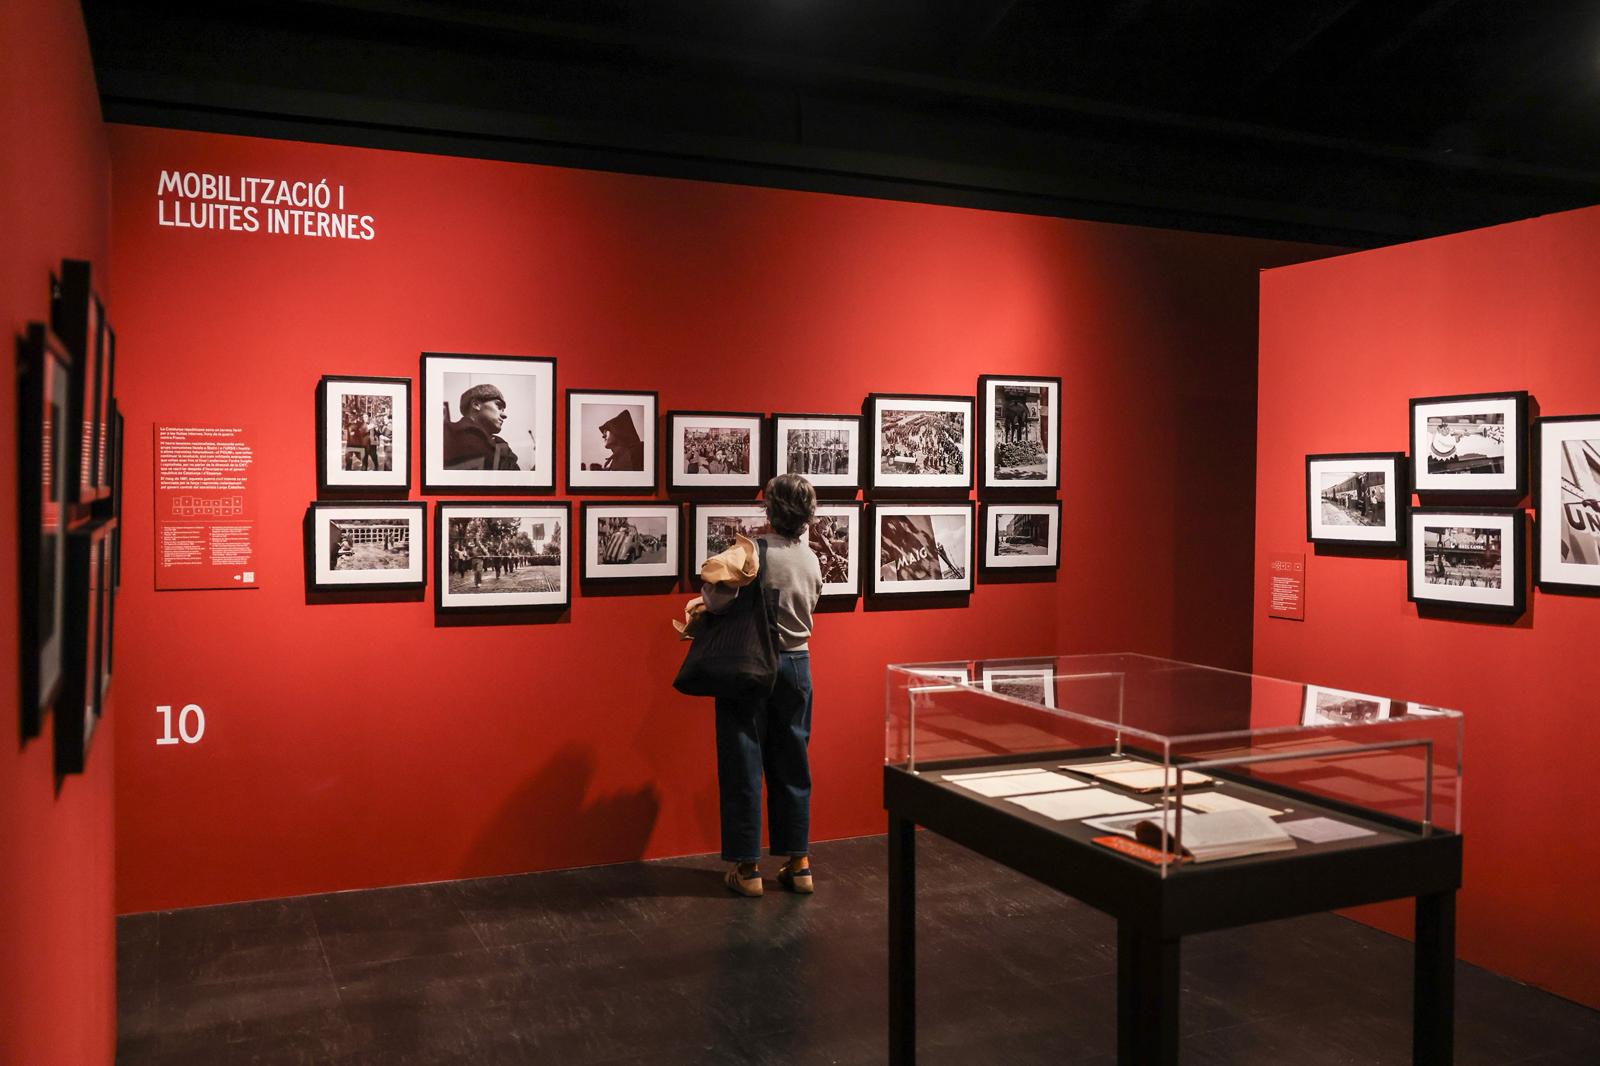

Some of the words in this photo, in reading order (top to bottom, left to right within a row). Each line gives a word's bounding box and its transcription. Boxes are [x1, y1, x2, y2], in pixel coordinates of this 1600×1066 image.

[157, 170, 331, 209] MOBILITZACIÓ
[338, 185, 344, 210] I
[158, 199, 260, 233] LLUITES
[267, 207, 376, 241] INTERNES
[897, 546, 928, 571] MAIG
[156, 703, 206, 745] 10
